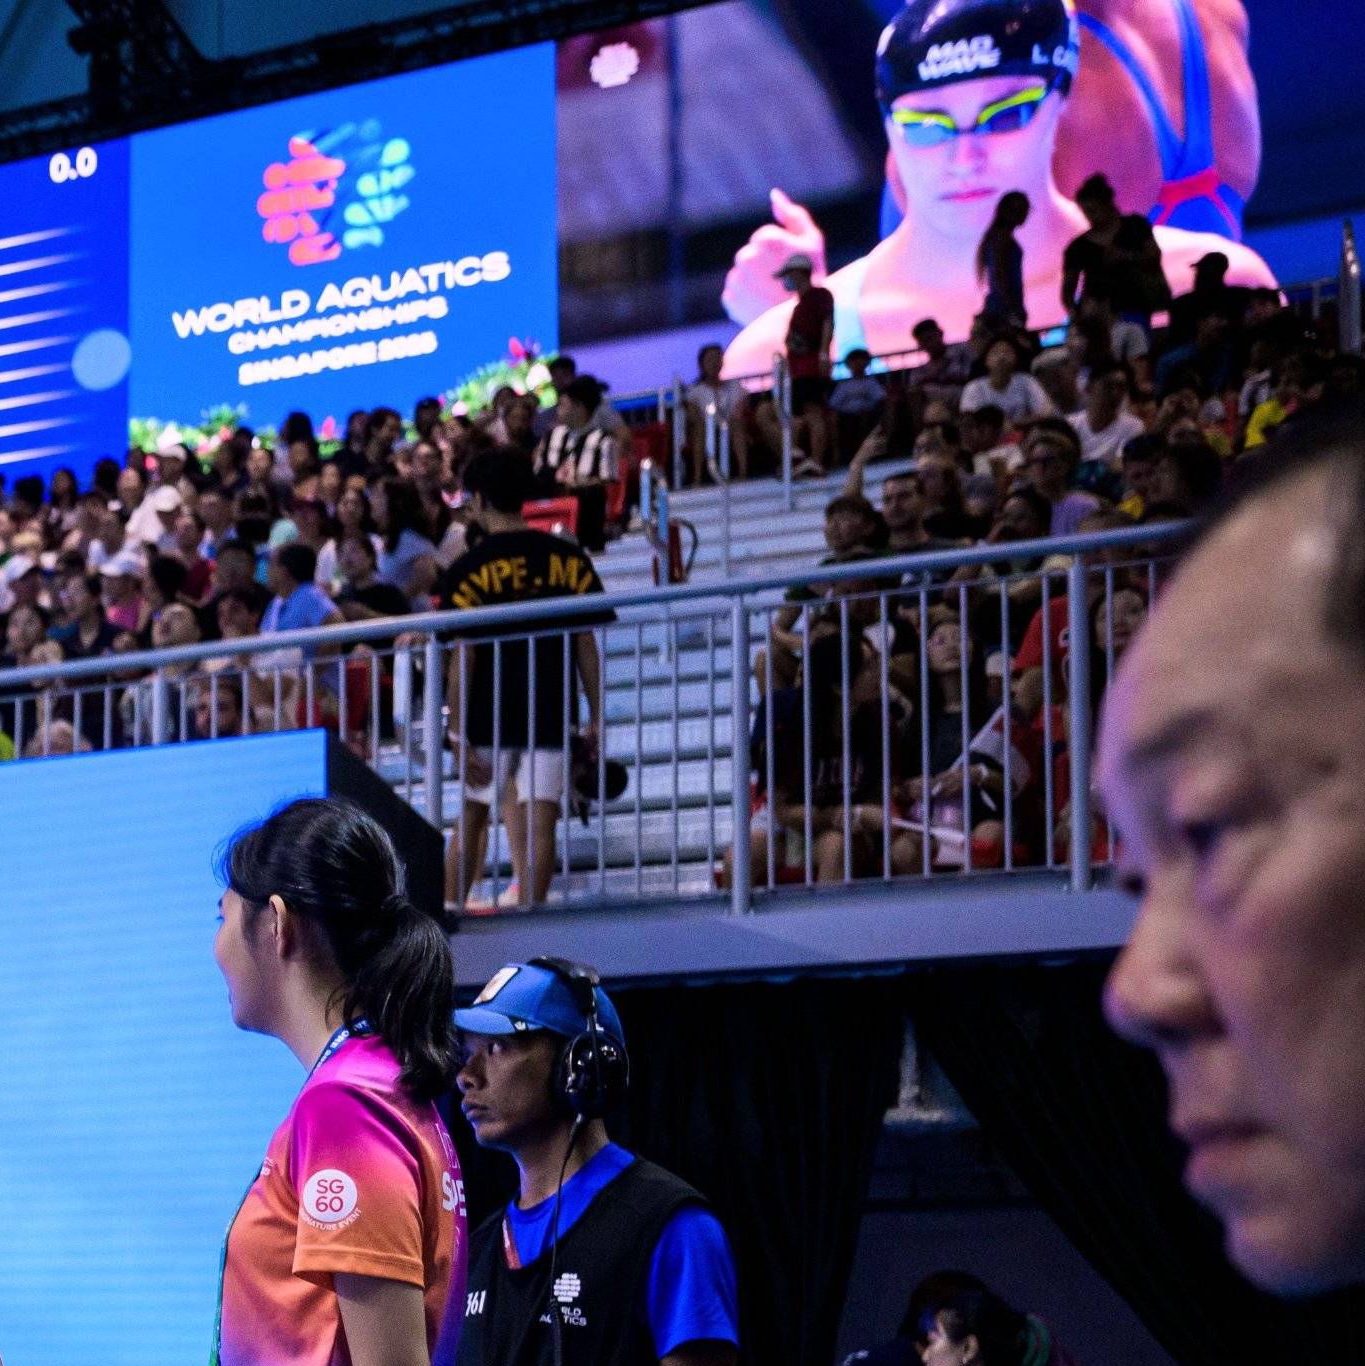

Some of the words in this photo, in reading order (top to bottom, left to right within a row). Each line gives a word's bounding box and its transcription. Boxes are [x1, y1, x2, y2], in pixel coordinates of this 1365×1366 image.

[49, 146, 97, 184] 0.0
[172, 290, 310, 338] WORLD
[316, 251, 512, 312] AQUATICS
[228, 296, 449, 354] CHAMPIONSHIPS
[315, 1195, 344, 1213] 60
[316, 1179, 345, 1194] SG
